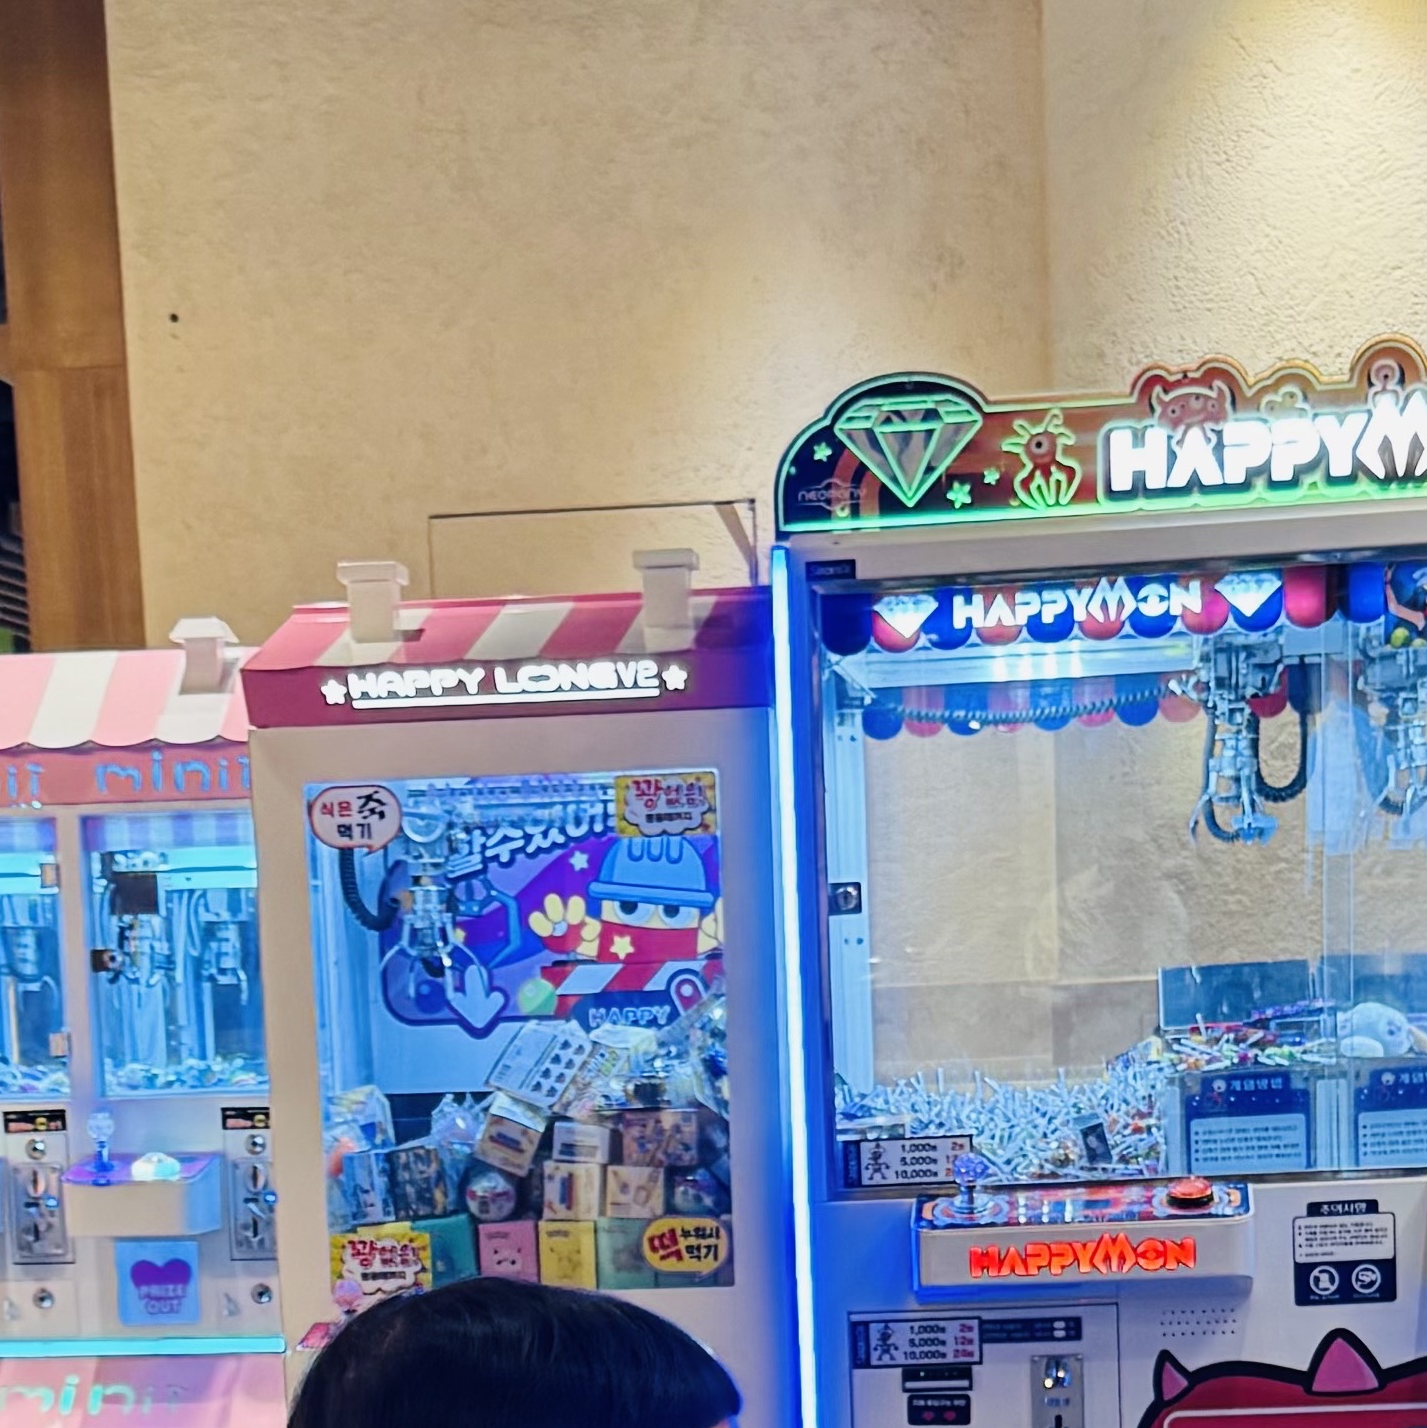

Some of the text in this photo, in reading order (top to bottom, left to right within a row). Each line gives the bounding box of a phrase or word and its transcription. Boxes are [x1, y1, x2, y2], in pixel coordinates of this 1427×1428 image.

[953, 577, 1202, 630] HAPPYMON
[347, 667, 485, 700] HAPPY
[337, 822, 372, 840] 먹기
[588, 1005, 671, 1028] HAPPY
[969, 1232, 1196, 1278] HAPPYMON
[145, 1299, 182, 1315] OUT
